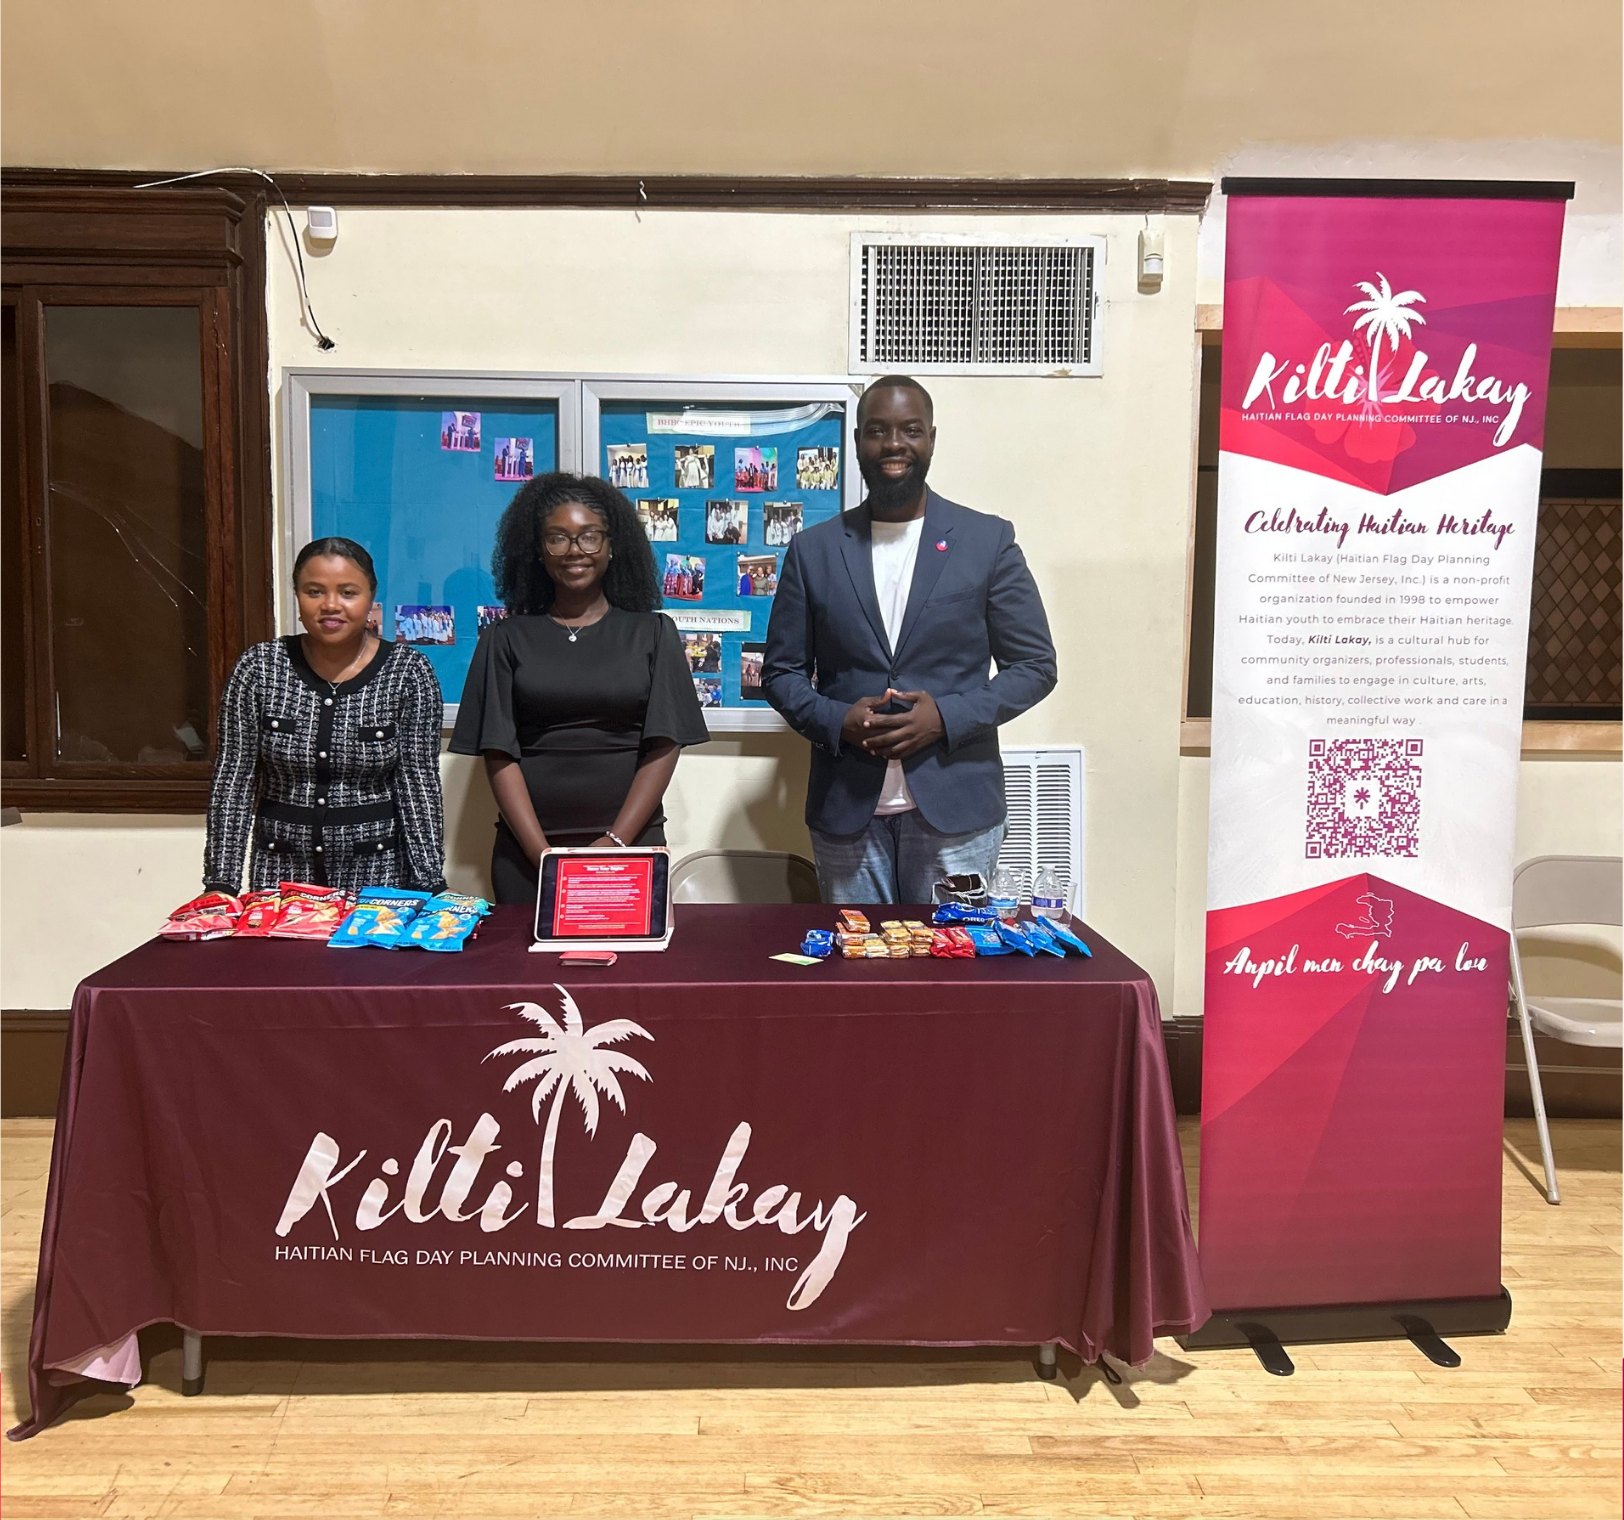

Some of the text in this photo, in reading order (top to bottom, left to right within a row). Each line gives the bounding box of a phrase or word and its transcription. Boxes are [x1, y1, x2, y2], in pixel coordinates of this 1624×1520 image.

[1242, 340, 1532, 447] Kilti Lakay
[1241, 412, 1282, 421] HAITIAN
[1285, 412, 1311, 421] FLAG
[1313, 413, 1333, 421] DAY
[1336, 413, 1381, 423] PLANNING
[1384, 414, 1442, 424] COMMITTEE
[1445, 415, 1459, 424] OF
[1482, 415, 1500, 424] INC
[1244, 507, 1515, 551] Celebrating Haitian Heritage
[1273, 552, 1491, 568] Kilti Lakay (Haitian Flag Day Planning
[1247, 572, 1511, 587] Committee of New Jersey, Inc.) is a non-profit
[1258, 591, 1500, 607] organization founded in 1998 to empower
[672, 615, 740, 625] OUTH NATIONS
[1238, 613, 1283, 625] Haitian
[1285, 613, 1320, 626] youth
[1322, 615, 1335, 625] to
[1336, 614, 1386, 625] embrace
[1388, 614, 1417, 625] their
[1419, 615, 1463, 625] Haitian
[1266, 633, 1490, 647] Today, Kilti Lakay, is a cultural hub for
[1240, 654, 1510, 667] community organizers, professionals, students,
[1266, 674, 1488, 687] and families to engage in culture, arts,
[1237, 694, 1508, 707] education, history, collective work and care in a
[1326, 714, 1390, 727] meaningful
[1392, 717, 1417, 728] way
[1223, 940, 1489, 994] Anpil men chay pa lou
[275, 1112, 868, 1311] Kilti Lakay
[274, 1245, 799, 1273] HAITIAN FLAG DAY PLANNING COMMITTEE OF NJ., INC
